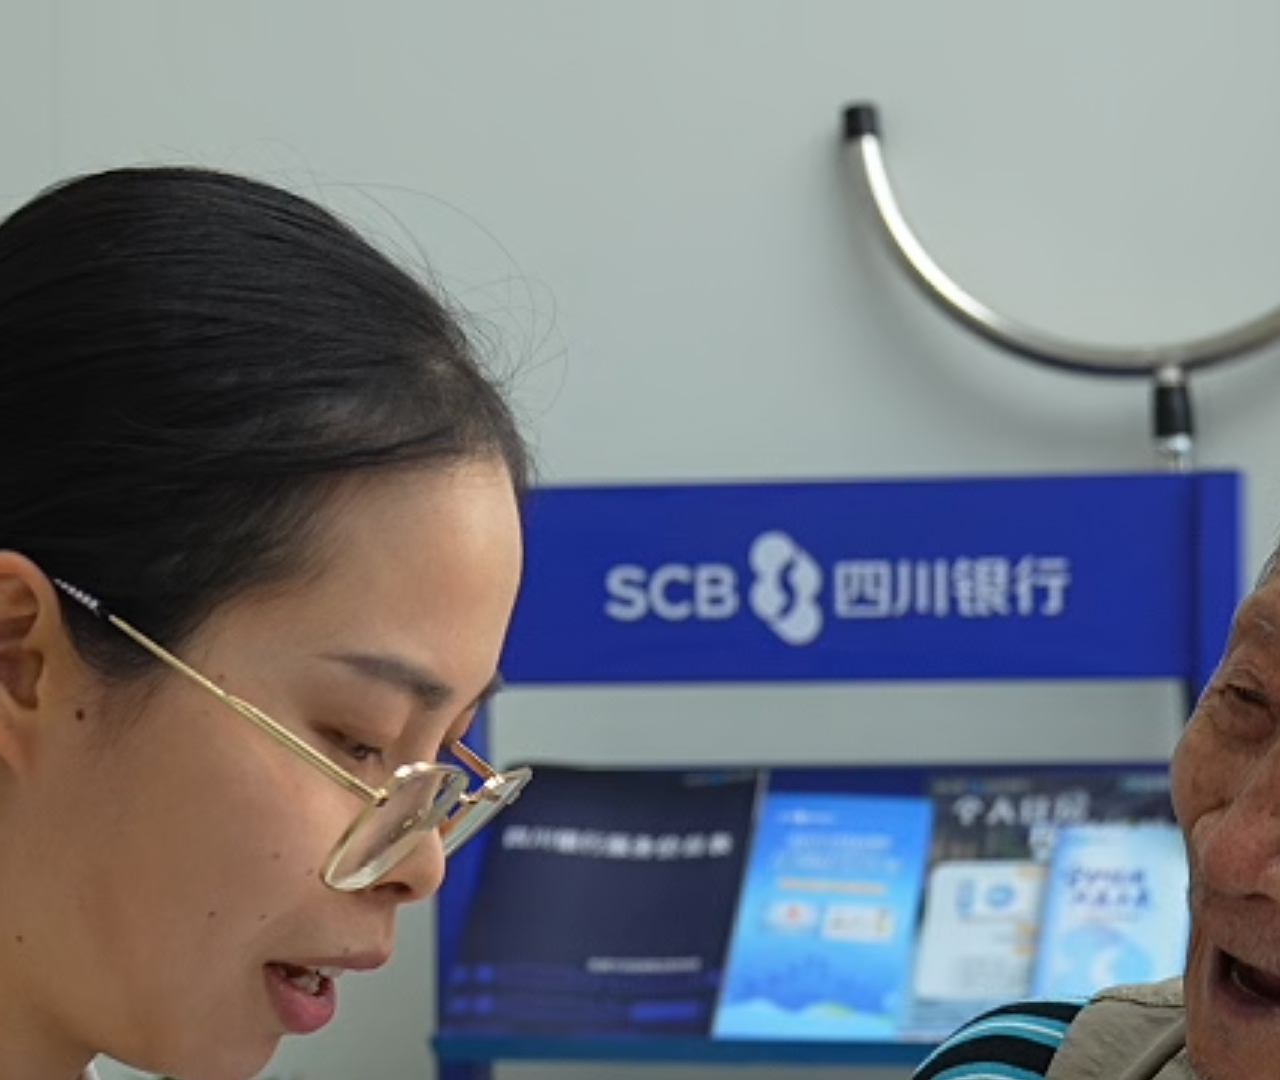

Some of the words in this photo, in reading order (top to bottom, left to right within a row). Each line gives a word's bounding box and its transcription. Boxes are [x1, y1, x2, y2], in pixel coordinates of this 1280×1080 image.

[604, 563, 740, 622] SCB
[833, 553, 1071, 620] 四川银行
